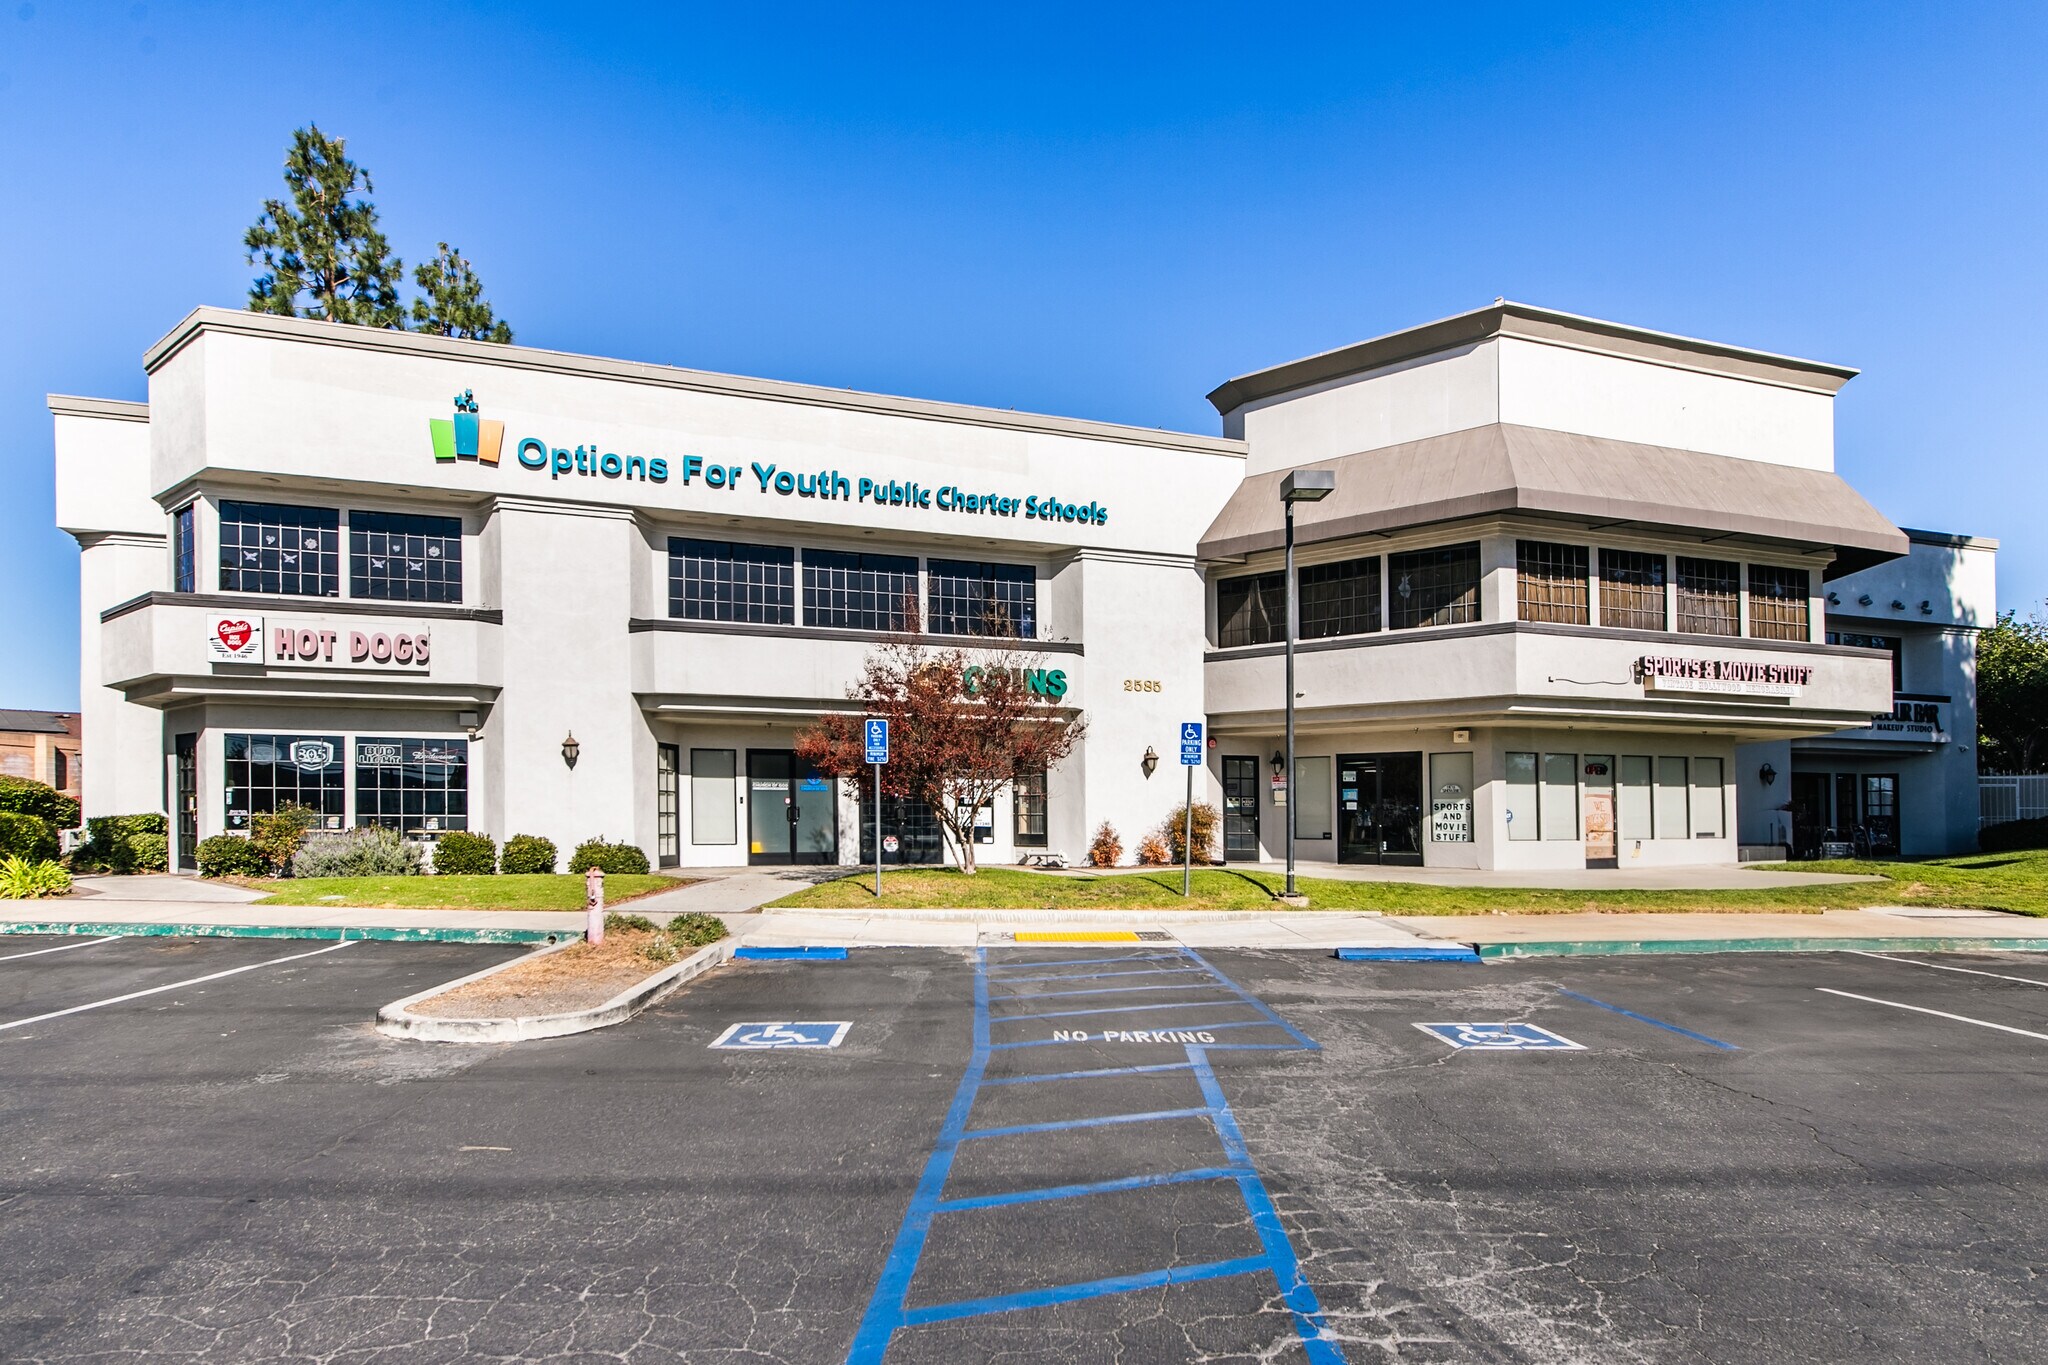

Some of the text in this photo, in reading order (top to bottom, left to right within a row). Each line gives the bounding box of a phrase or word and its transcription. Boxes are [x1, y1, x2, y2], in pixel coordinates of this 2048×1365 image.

[518, 437, 1108, 523] Options For Youth Public Charter Schools
[274, 627, 430, 663] HOT DOGS
[1644, 656, 1815, 685] SPORTS & MOVIE STUFF
[1123, 679, 1162, 693] 2585
[1698, 681, 1742, 692] HOLLYWOOD
[1745, 684, 1795, 696] MEMORABILIA
[1876, 724, 1904, 732] MAKEUP
[1907, 724, 1933, 733] STUDIO
[298, 748, 327, 760] 805
[364, 746, 395, 756] BUD
[1434, 803, 1471, 811] SPORTS
[1443, 812, 1462, 820] AND
[1435, 822, 1467, 831] MOVIE
[1436, 833, 1467, 841] STUFF
[1053, 1030, 1216, 1043] NO PARKING
